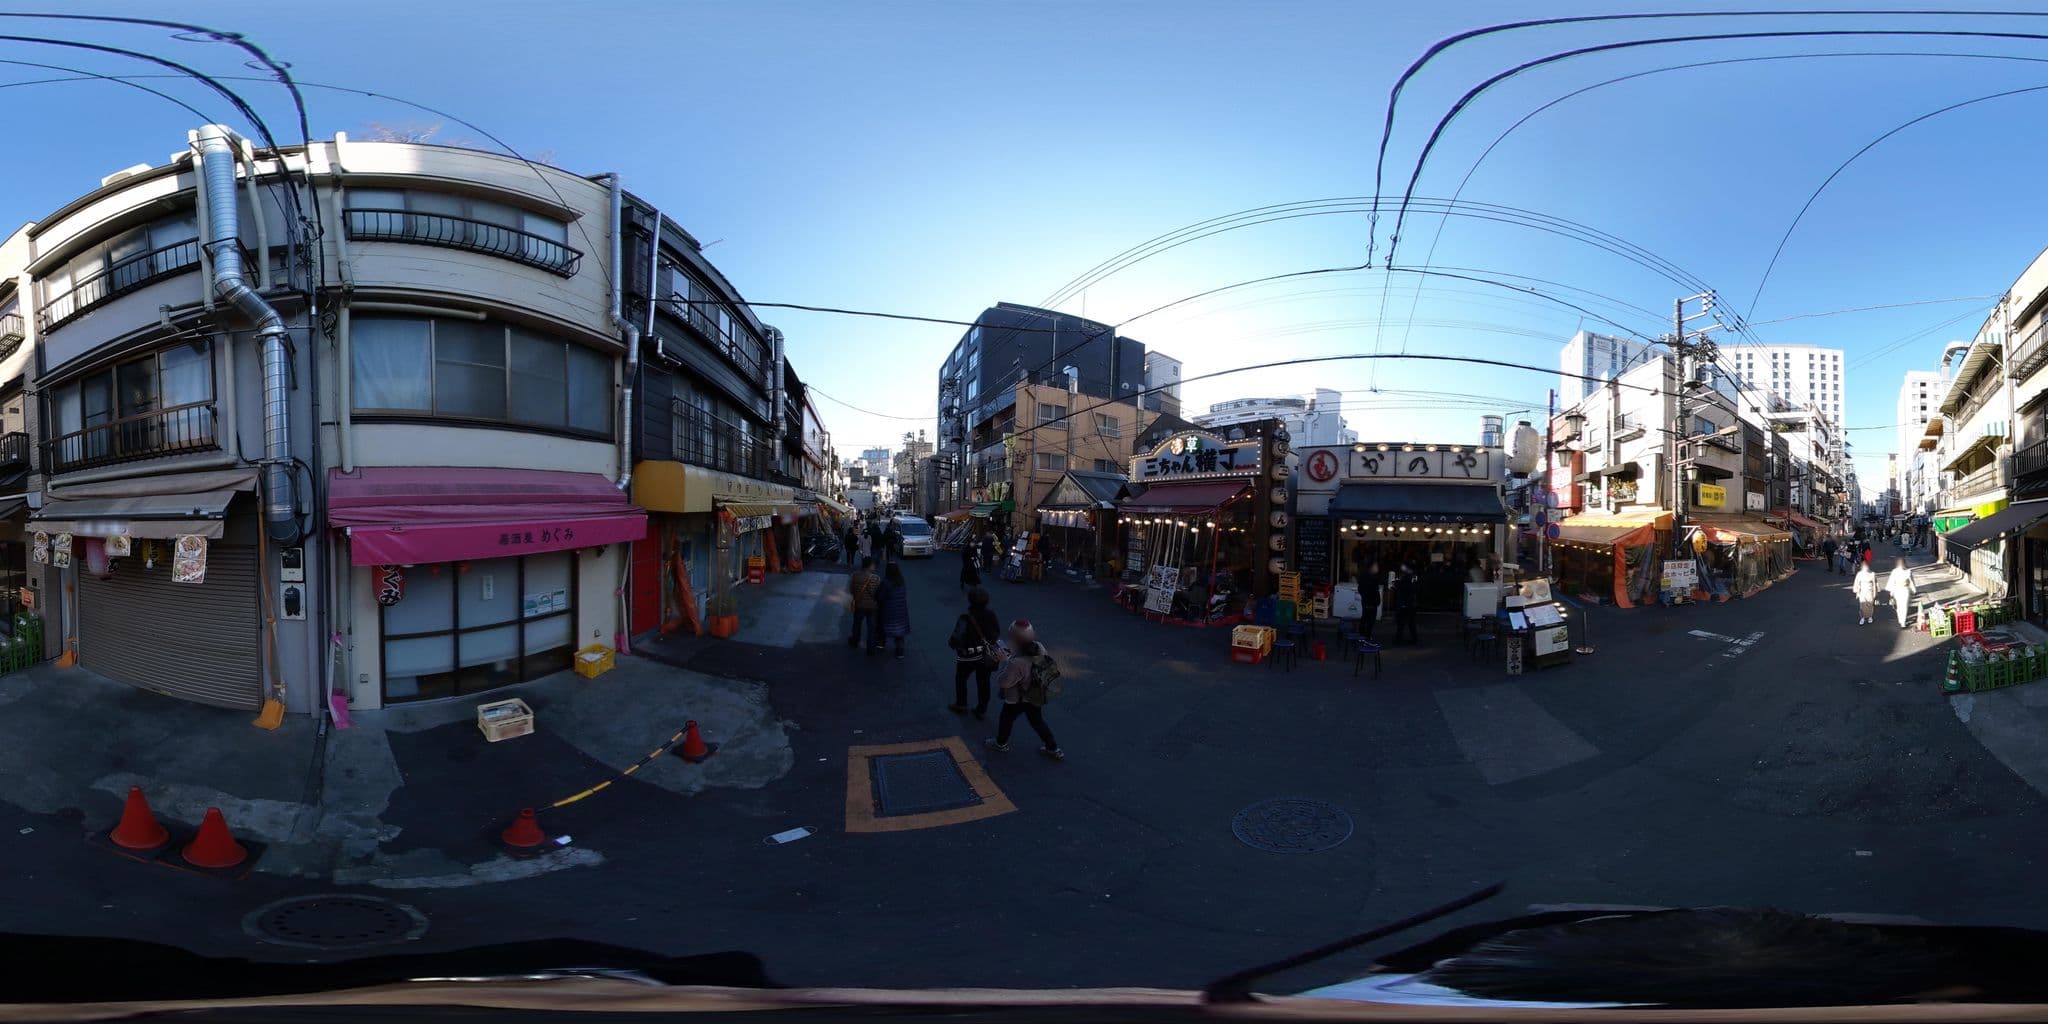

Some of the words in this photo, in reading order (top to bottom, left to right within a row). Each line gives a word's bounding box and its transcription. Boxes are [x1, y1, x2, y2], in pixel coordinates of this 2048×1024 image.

[1144, 447, 1239, 477] 三ちゃん横丁
[1361, 453, 1477, 477] かのや
[540, 527, 575, 543] めぐみ
